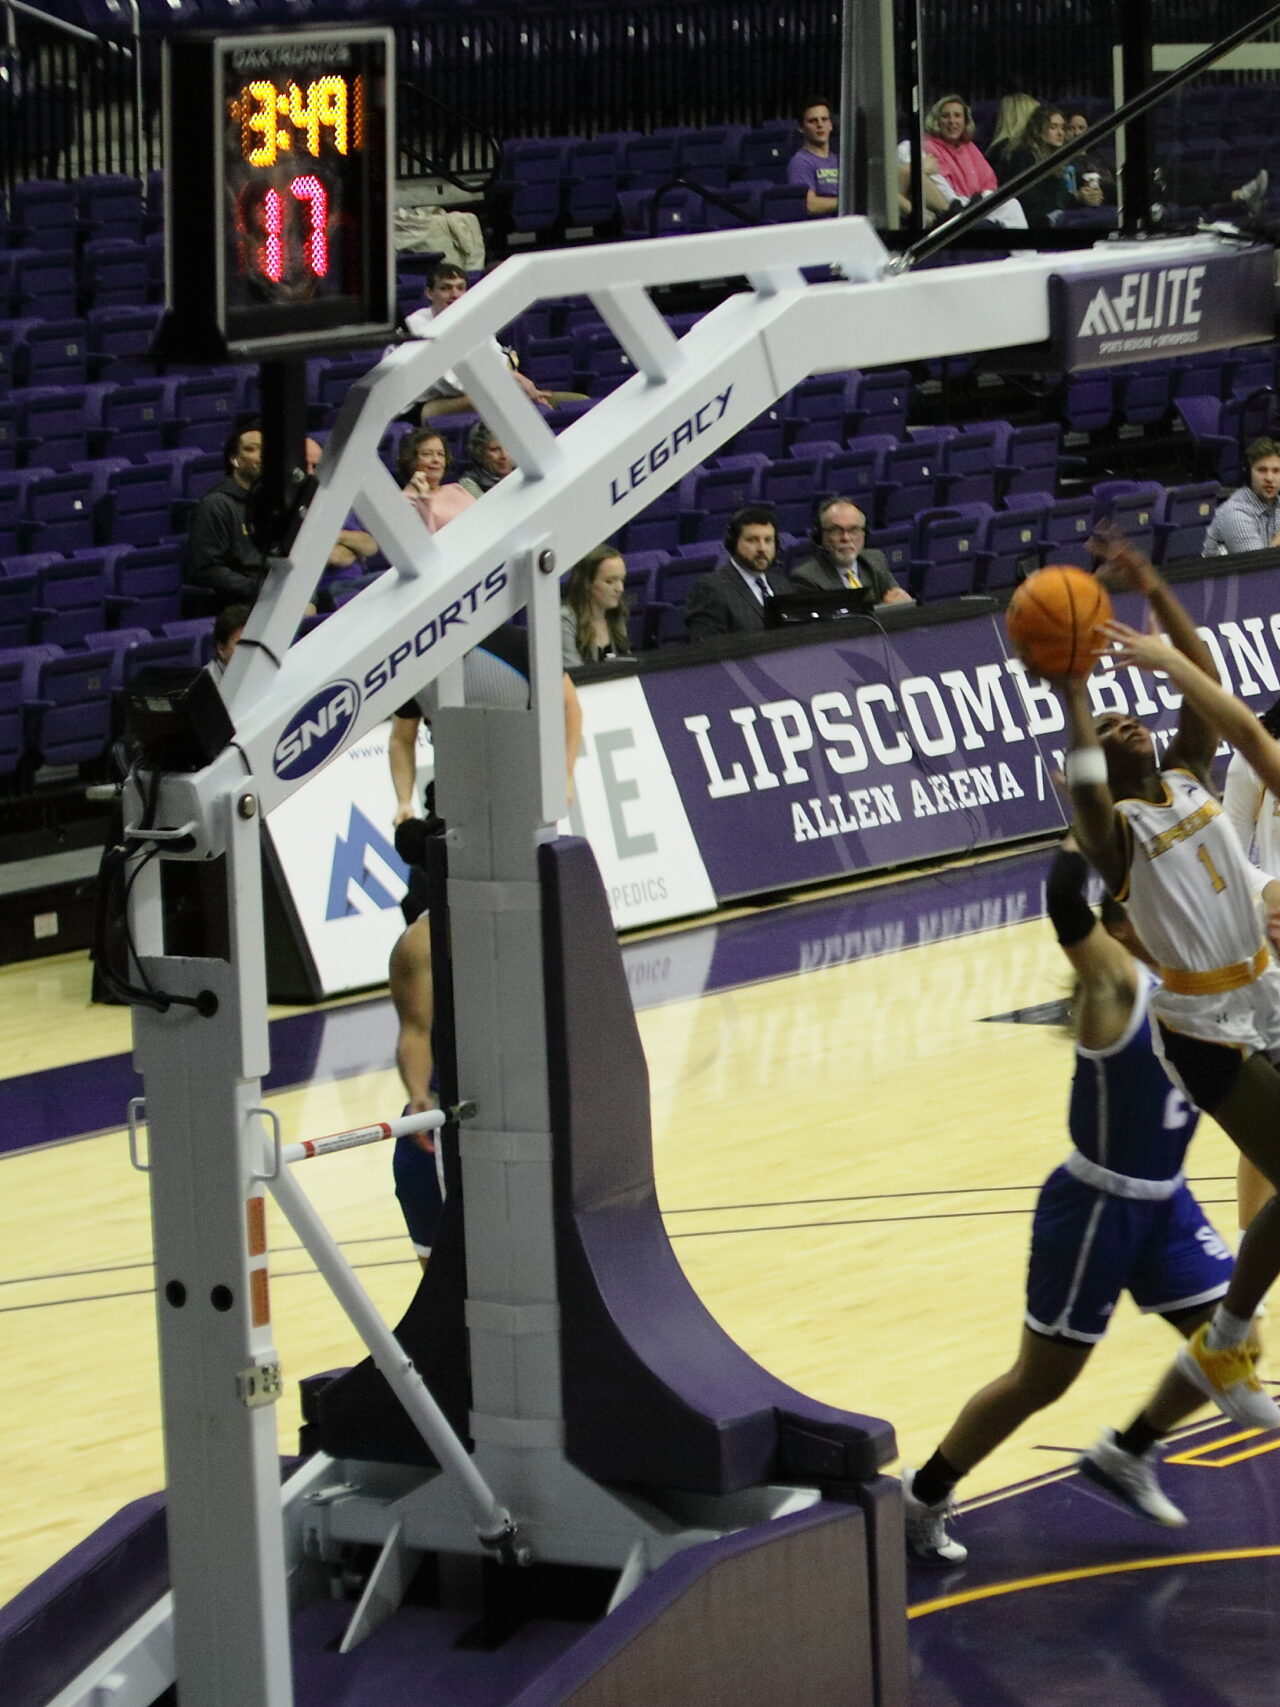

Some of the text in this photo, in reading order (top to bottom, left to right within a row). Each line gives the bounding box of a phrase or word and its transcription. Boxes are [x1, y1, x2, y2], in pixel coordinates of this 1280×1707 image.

[247, 74, 348, 168] 3:49
[264, 174, 328, 283] 17
[609, 382, 735, 507] LEGACY
[274, 561, 509, 776] SNA SPORTS
[684, 659, 1065, 799] LIPSCOMB
[790, 783, 902, 843] ALLEN
[910, 761, 1025, 818] ARENA
[612, 876, 668, 909] PEDICS
[1197, 843, 1227, 894] 1
